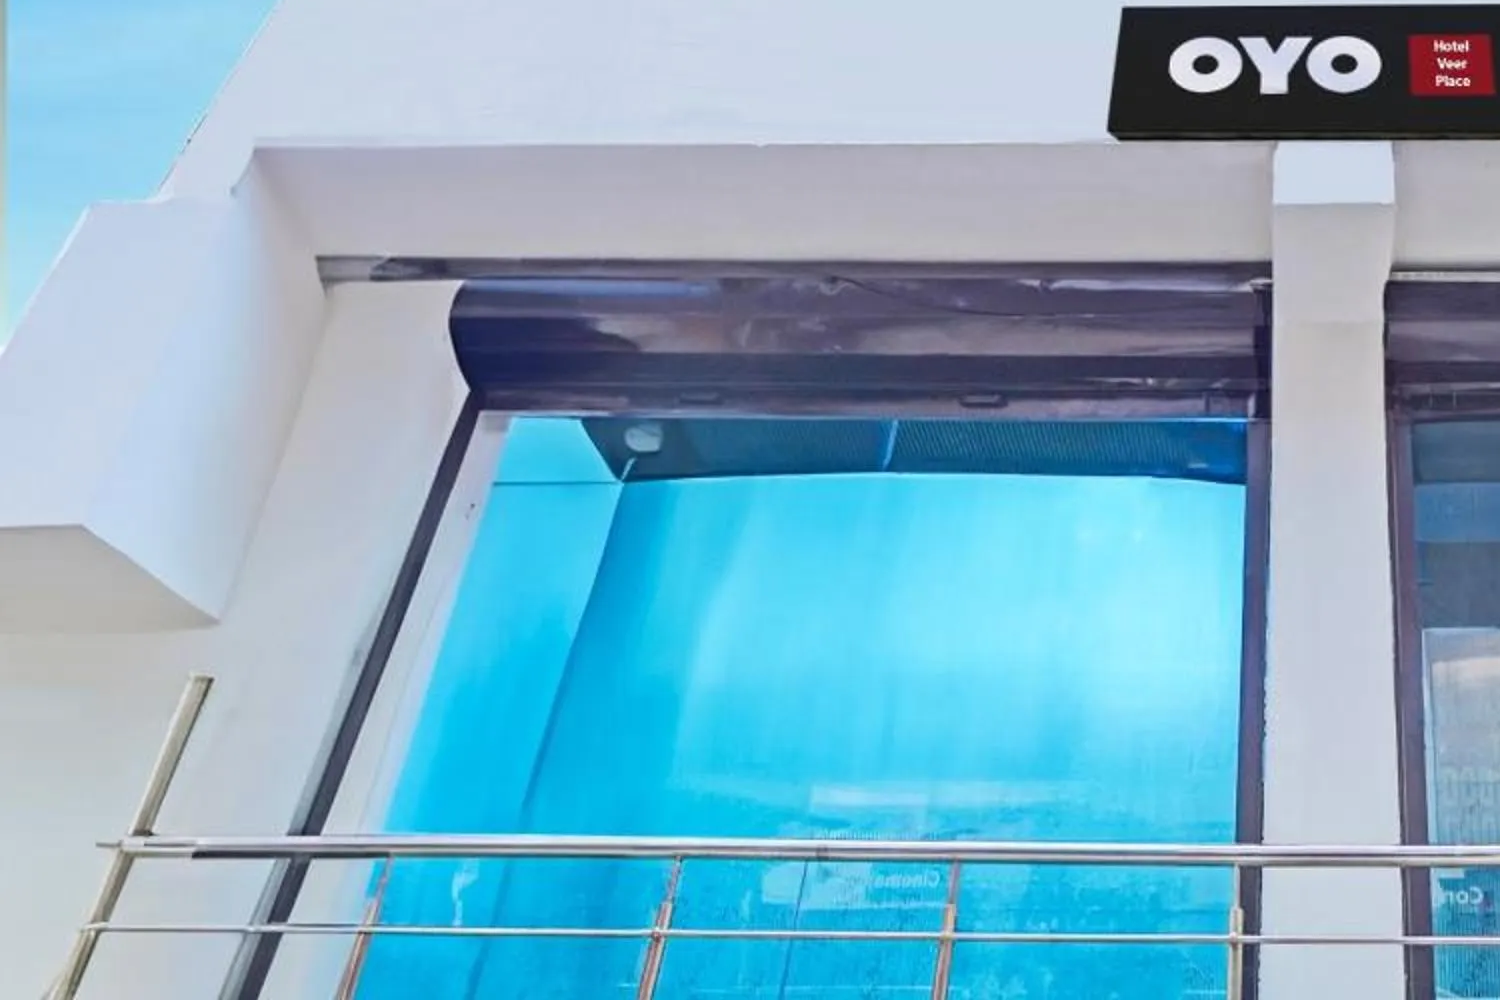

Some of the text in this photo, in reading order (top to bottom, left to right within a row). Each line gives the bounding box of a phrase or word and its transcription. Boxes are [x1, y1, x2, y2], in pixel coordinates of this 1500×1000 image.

[1433, 39, 1469, 53] Hotel
[1168, 35, 1382, 94] OYO
[1436, 57, 1467, 70] Veer
[1435, 74, 1471, 87] Place
